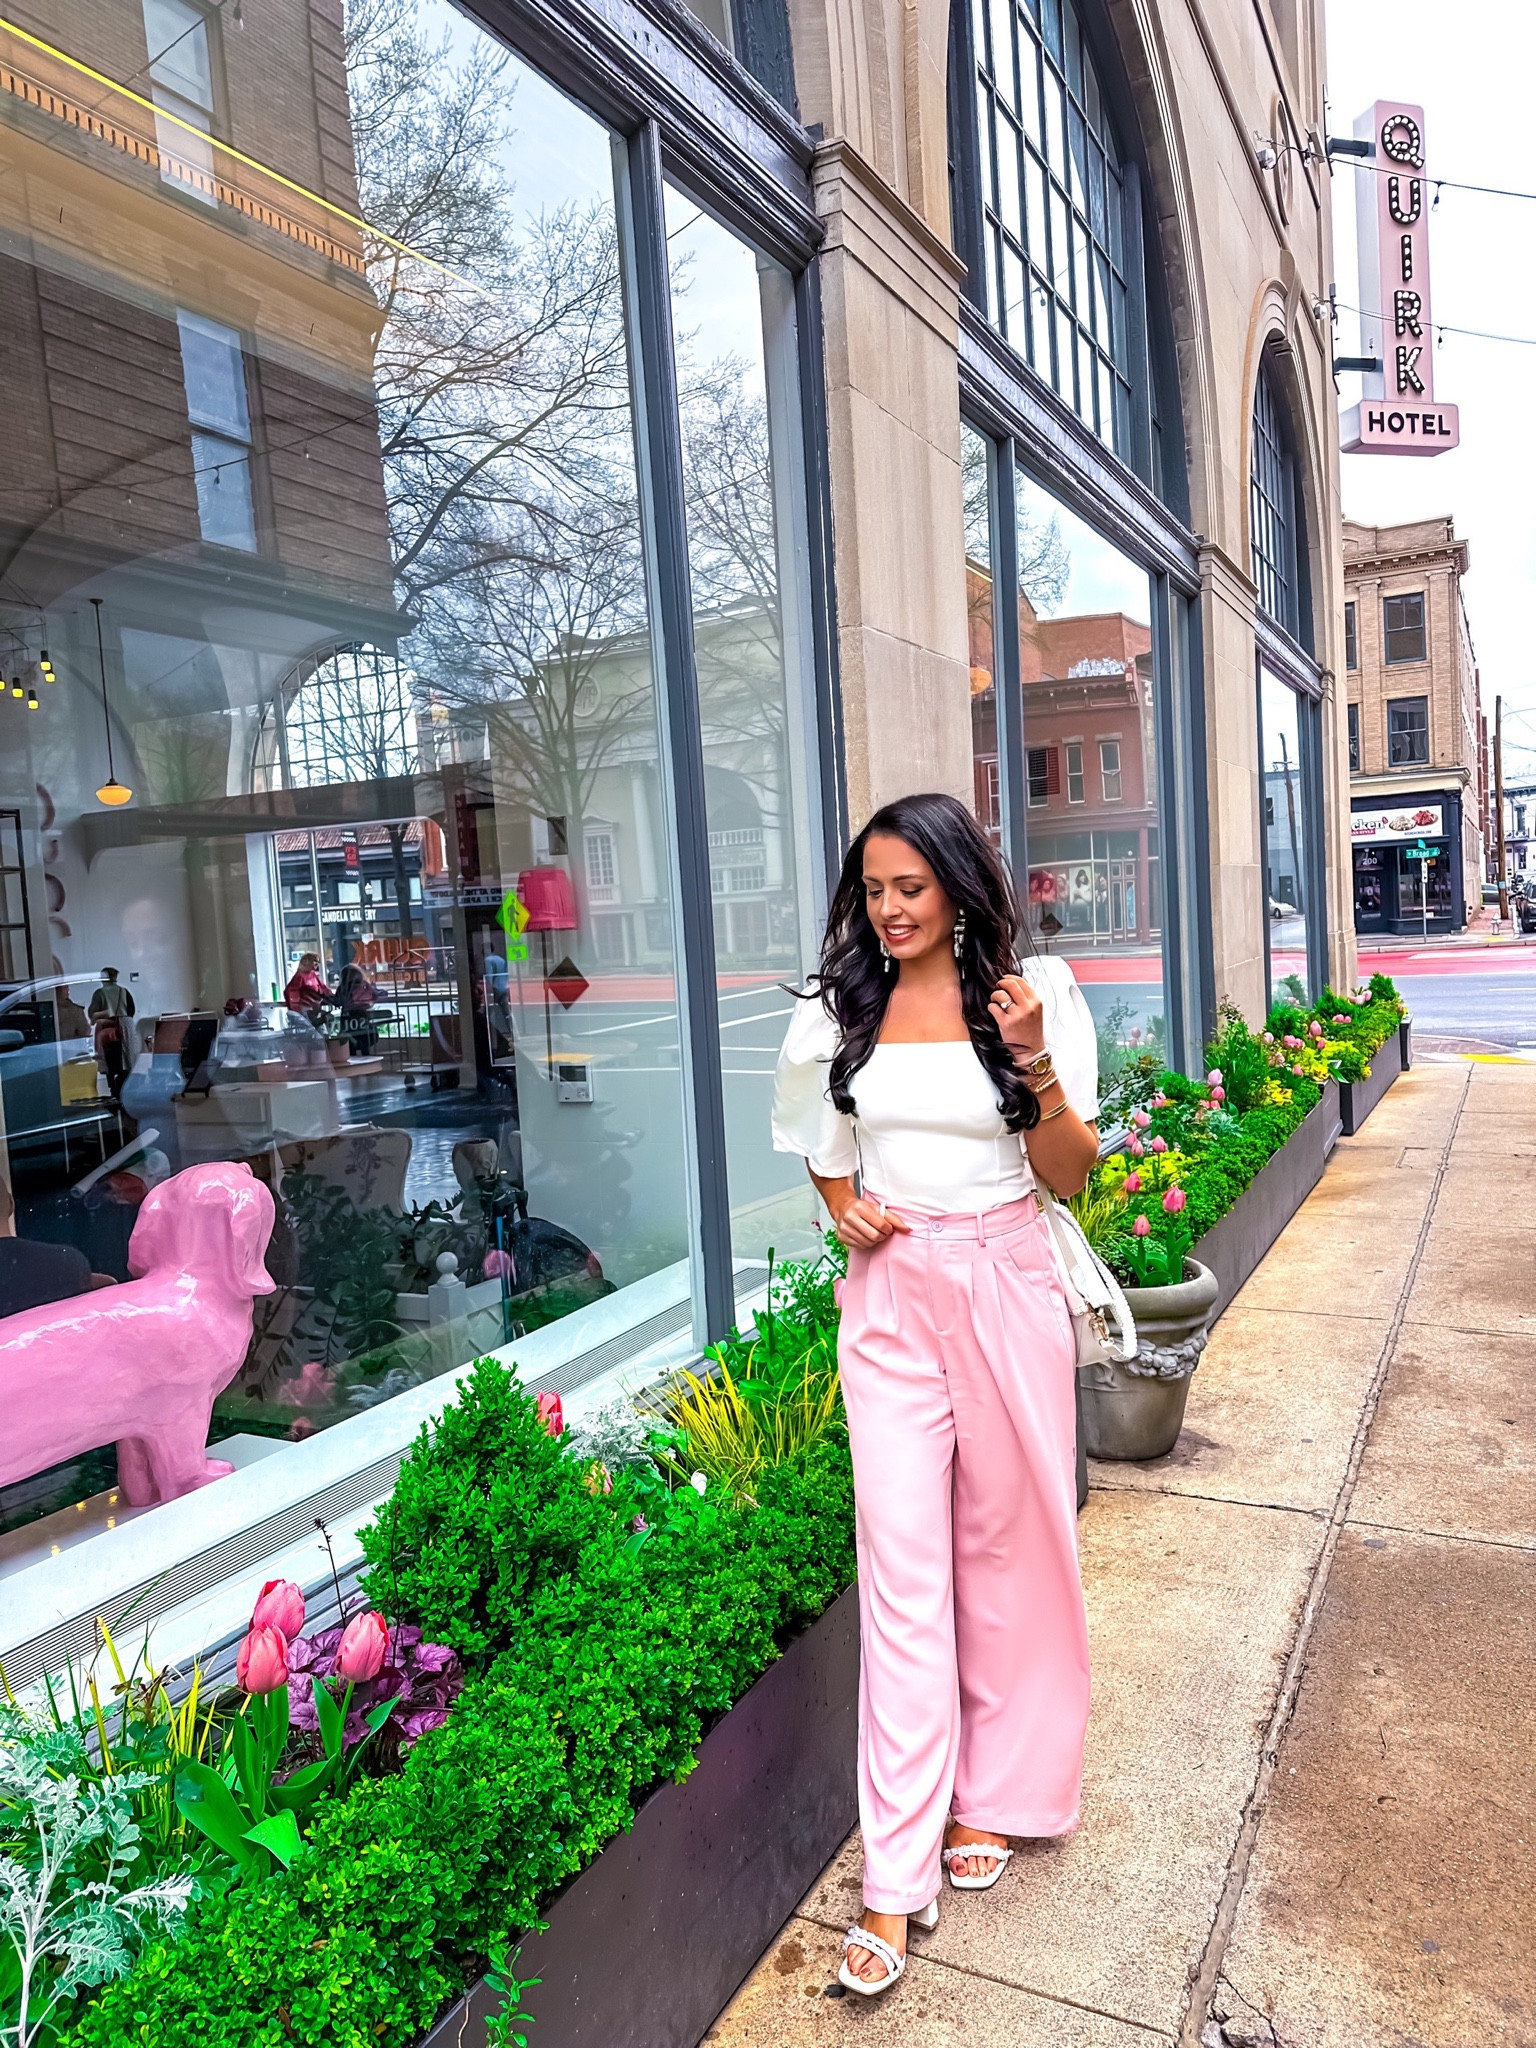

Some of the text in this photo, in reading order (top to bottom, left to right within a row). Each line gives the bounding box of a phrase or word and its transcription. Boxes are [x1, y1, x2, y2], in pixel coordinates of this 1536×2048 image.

[1381, 114, 1424, 395] QUIRK
[1368, 411, 1451, 436] HOTEL
[1413, 849, 1430, 858] Broad
[1362, 857, 1378, 866] 200
[321, 909, 376, 923] CANDELA GALERY
